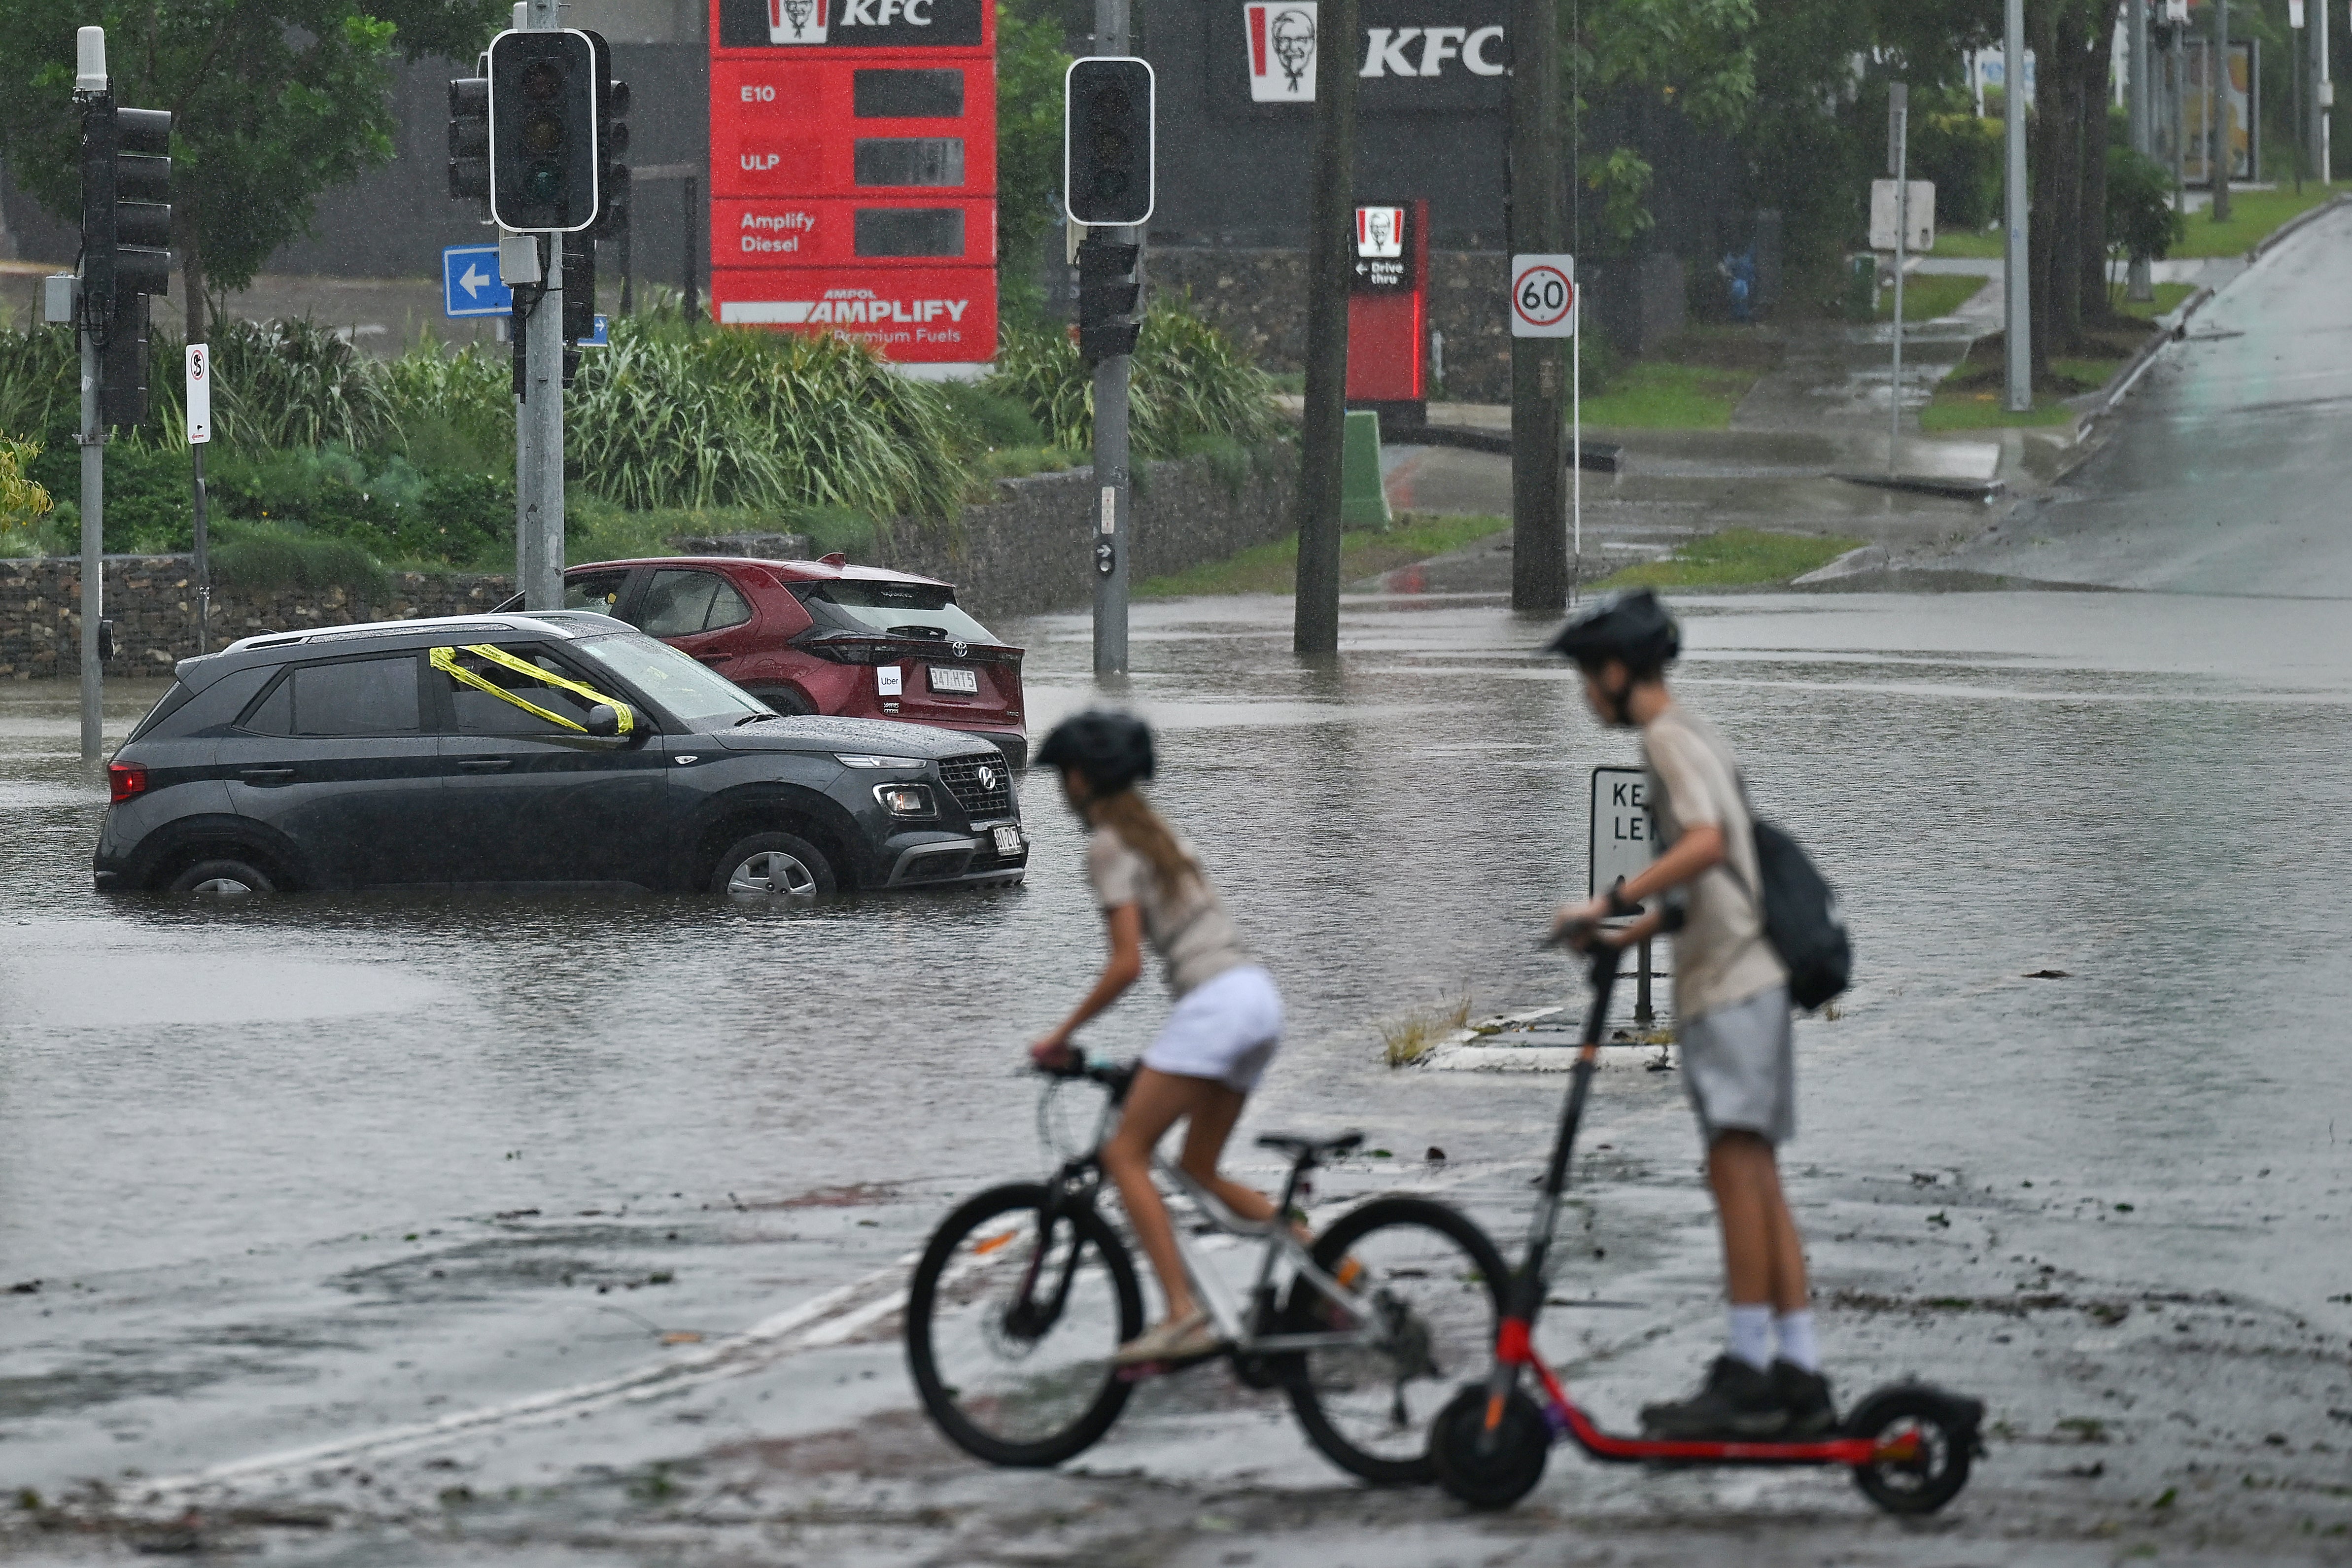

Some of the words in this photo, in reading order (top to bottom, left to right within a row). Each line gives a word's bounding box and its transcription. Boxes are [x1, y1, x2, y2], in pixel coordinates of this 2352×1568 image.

[840, 0, 932, 26] KFC
[1359, 26, 1513, 77] KFC
[741, 85, 776, 102] E10
[741, 154, 780, 170] ULP
[741, 212, 815, 232] Amplify
[741, 236, 798, 252] Diesel
[1371, 261, 1403, 274] Drive
[1371, 274, 1397, 284] thru
[824, 289, 876, 300] AMPOL
[1522, 280, 1563, 310] 60
[808, 299, 968, 323] AMPLIFY
[916, 328, 961, 343] Fuels
[881, 677, 899, 686] Uber
